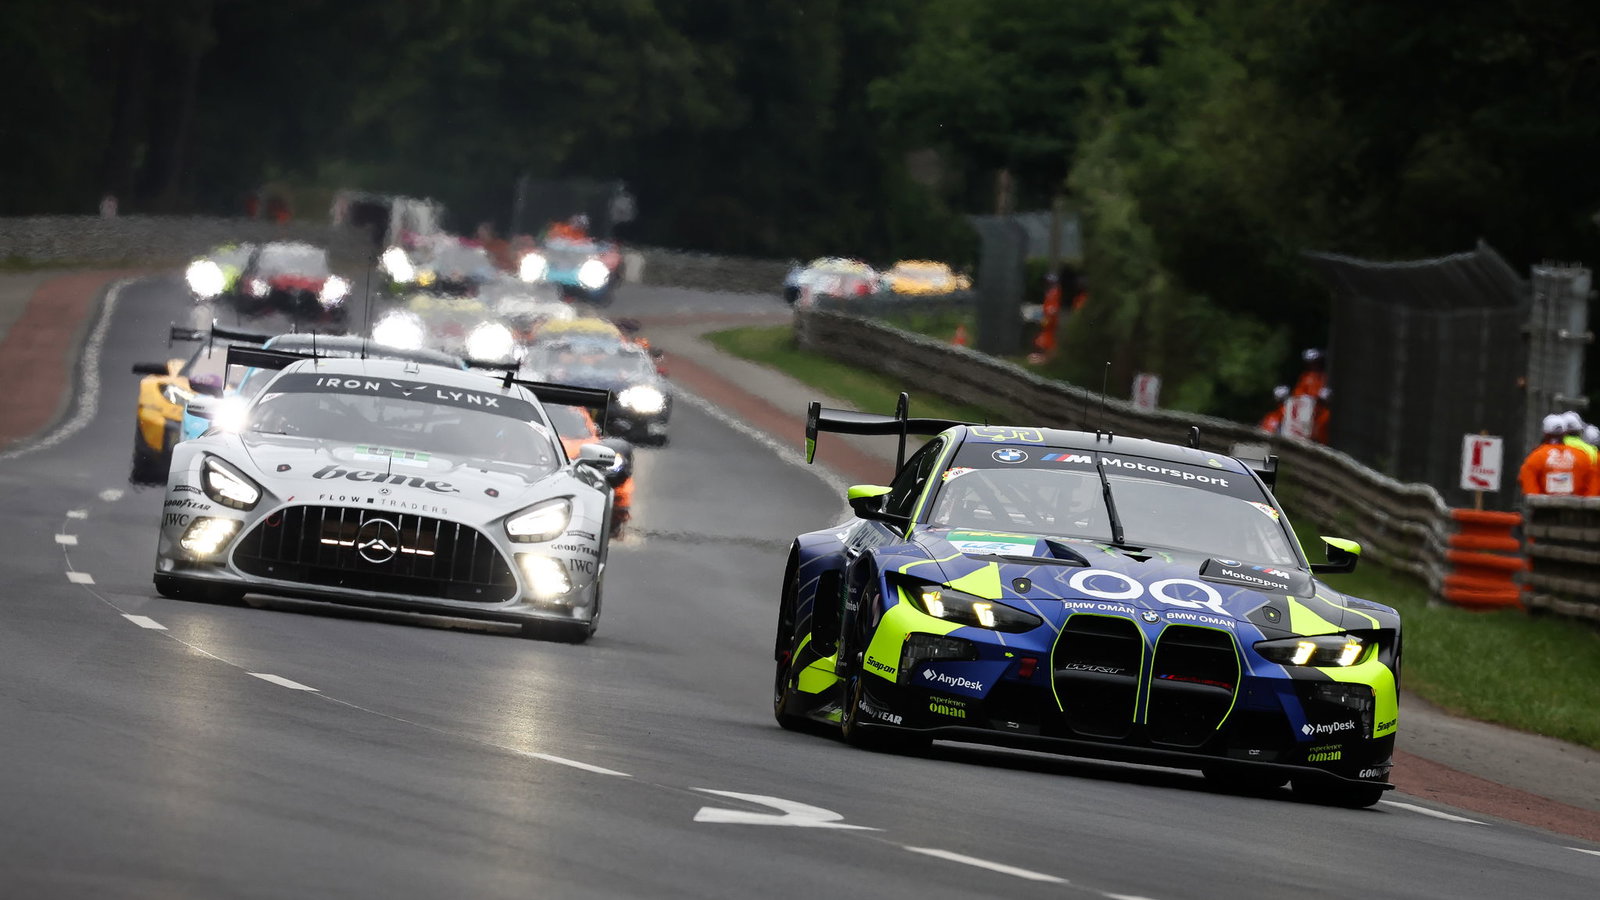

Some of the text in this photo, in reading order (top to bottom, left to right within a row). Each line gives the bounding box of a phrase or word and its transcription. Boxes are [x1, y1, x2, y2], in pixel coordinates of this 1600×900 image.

[316, 377, 500, 408] IRON LYNX
[312, 465, 460, 493] beme
[1102, 457, 1229, 487] Motorsport
[319, 493, 448, 515] FLOW TRADERS
[164, 512, 190, 527] IWC
[570, 558, 593, 575] IWC
[1221, 568, 1289, 591] Motorsport
[1069, 569, 1233, 616] OQ
[1097, 603, 1135, 614] OMAN
[1166, 612, 1197, 620] BMW
[1199, 615, 1235, 629] OMAN
[866, 656, 896, 675] Snap-on
[937, 672, 983, 692] AnyDesk
[929, 695, 966, 707] experience
[929, 702, 966, 719] oman
[1316, 719, 1356, 735] AnyDesk
[1307, 750, 1342, 762] oman
[1309, 743, 1343, 753] experience
